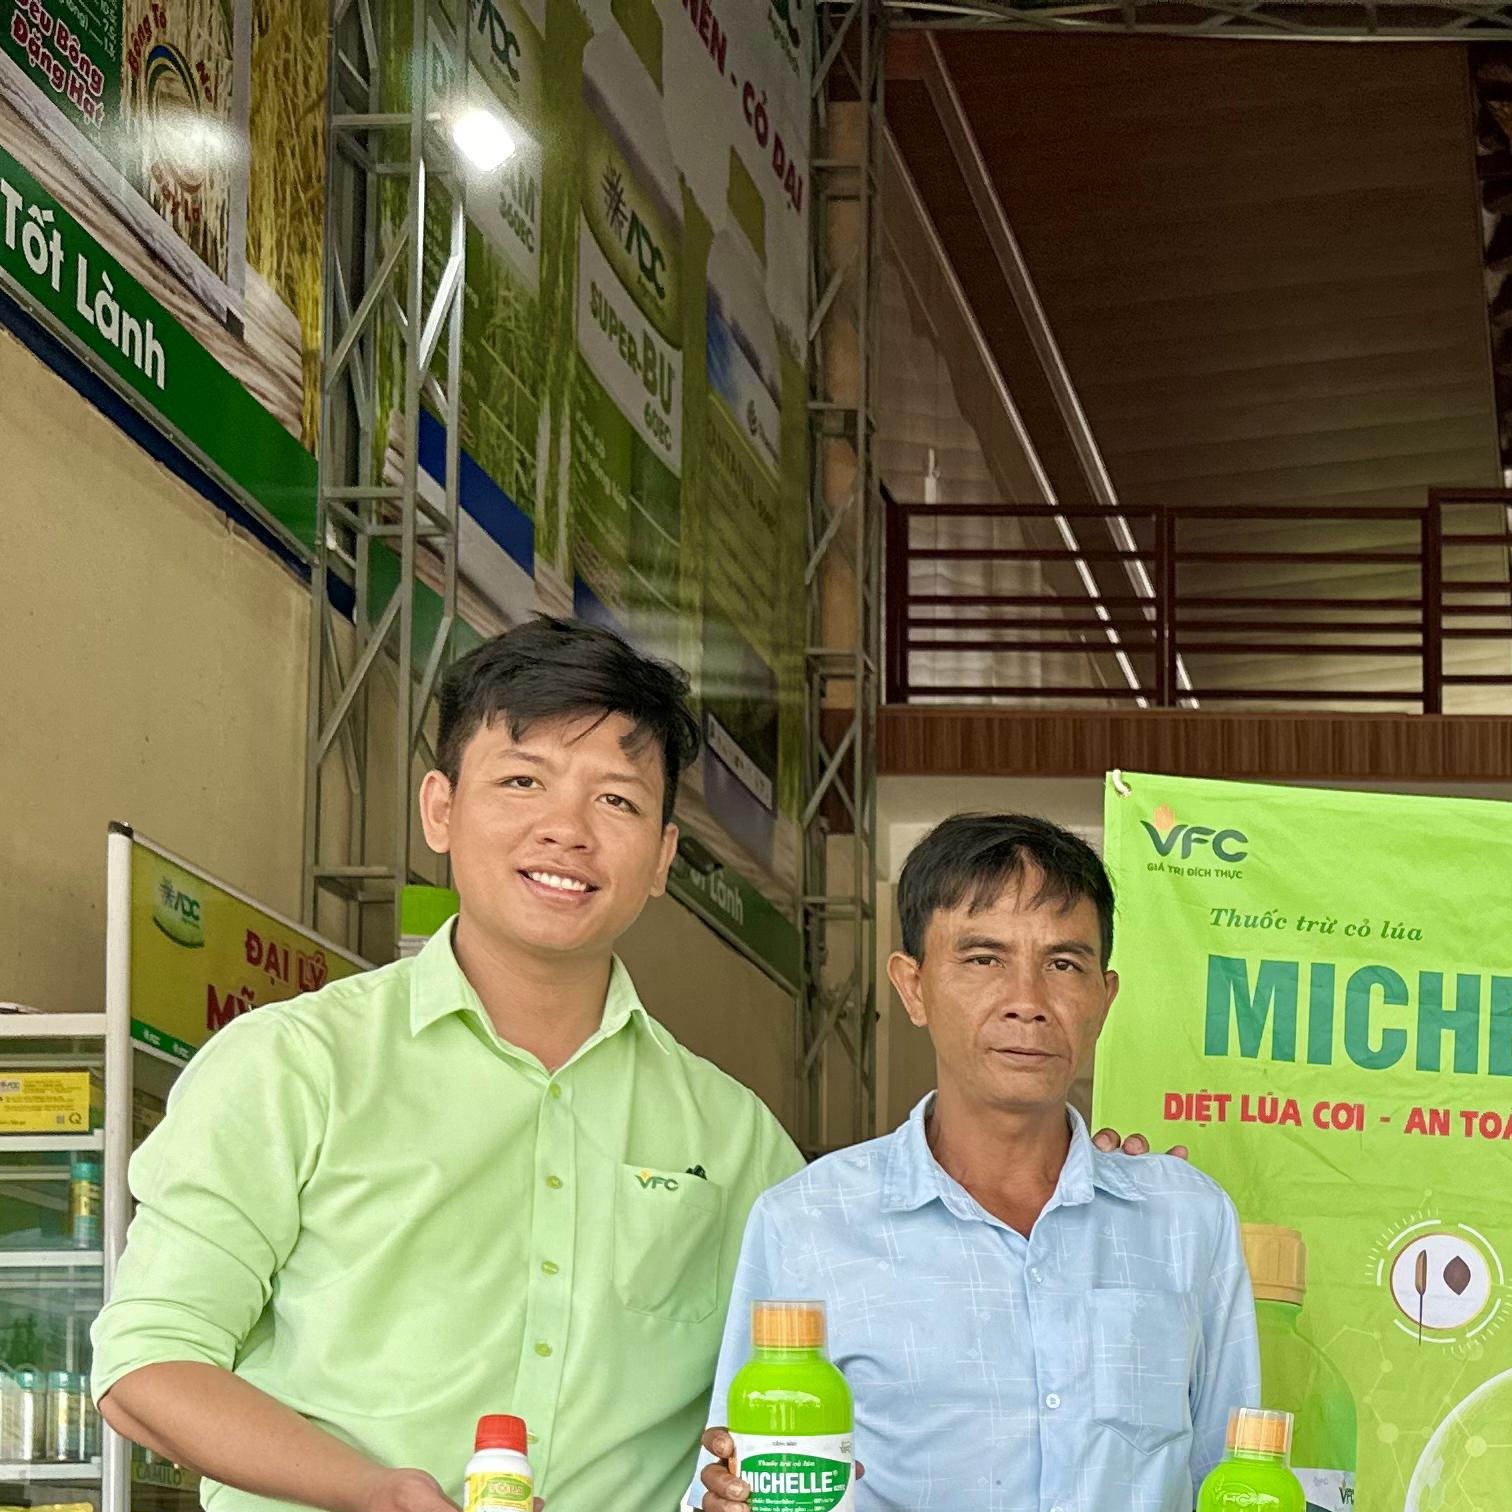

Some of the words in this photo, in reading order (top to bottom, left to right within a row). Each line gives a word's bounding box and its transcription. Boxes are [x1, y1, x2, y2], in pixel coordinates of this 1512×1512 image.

[1, 178, 64, 292] Tốt
[76, 253, 166, 390] Lành
[1140, 819, 1249, 863] VFC
[1147, 862, 1165, 873] GIÁ
[1167, 865, 1185, 877] TRỊ
[1214, 868, 1243, 880] THỰC
[1210, 907, 1287, 931] Thuốc
[1296, 915, 1338, 936] trừ
[1344, 918, 1371, 938] cỏ
[1380, 920, 1423, 942] lúa
[245, 928, 289, 986] ĐẠI
[1163, 1088, 1232, 1128] DIỆT
[1240, 1091, 1303, 1128] LÚA
[1403, 1107, 1451, 1137] AN
[634, 1174, 679, 1192] VFC
